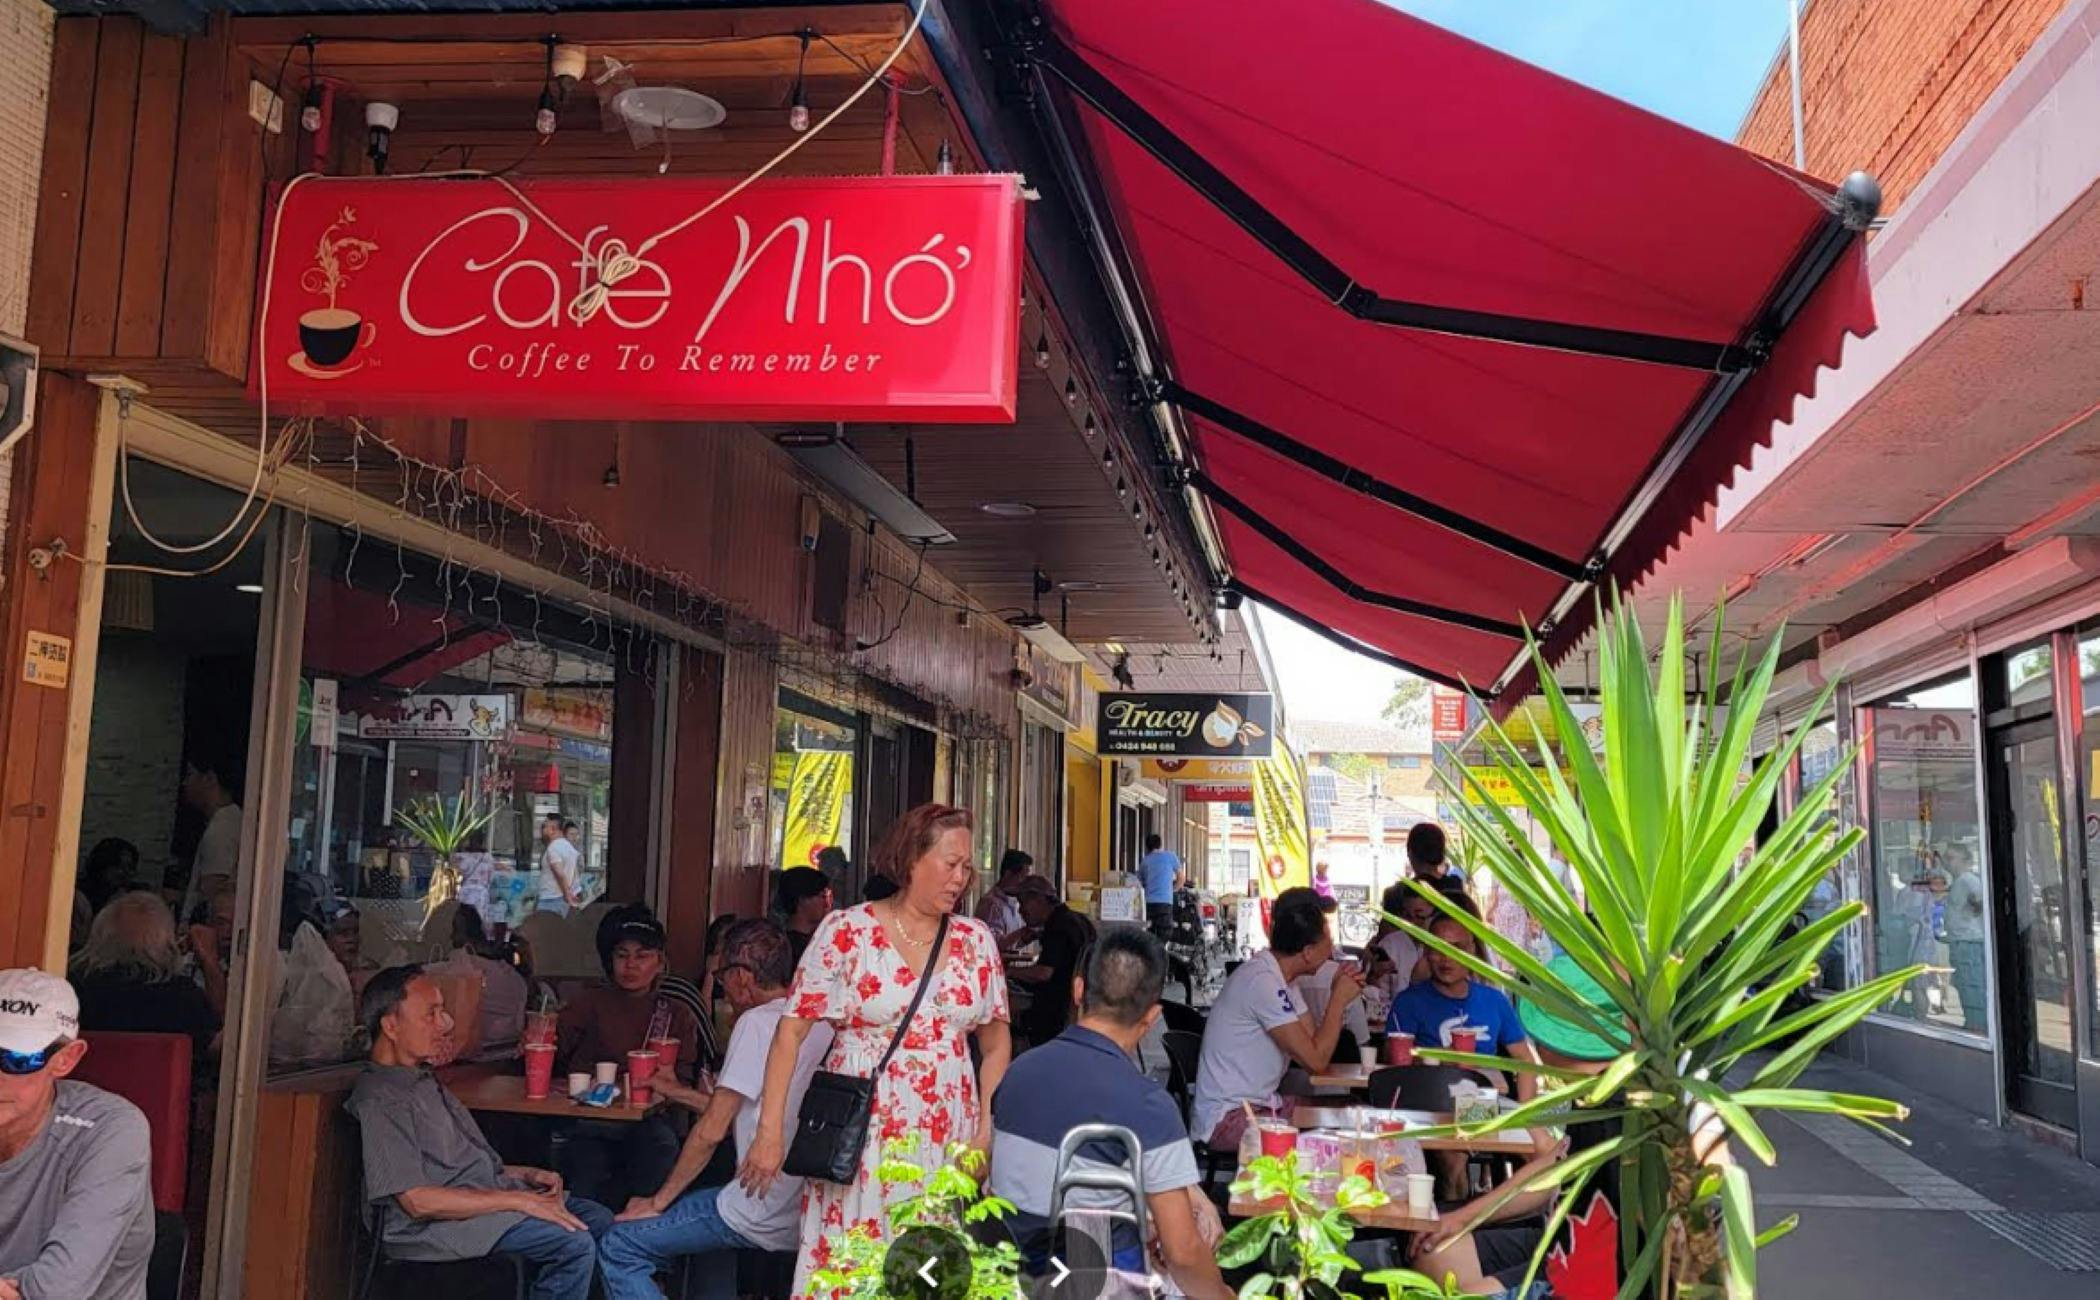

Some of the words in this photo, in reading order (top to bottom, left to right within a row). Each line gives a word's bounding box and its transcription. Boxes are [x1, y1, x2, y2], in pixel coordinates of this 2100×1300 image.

[467, 342, 592, 378] Coffee
[616, 344, 656, 371] To
[679, 344, 882, 372] Remember
[1105, 700, 1200, 737] Tracy
[1278, 989, 1294, 1012] 3
